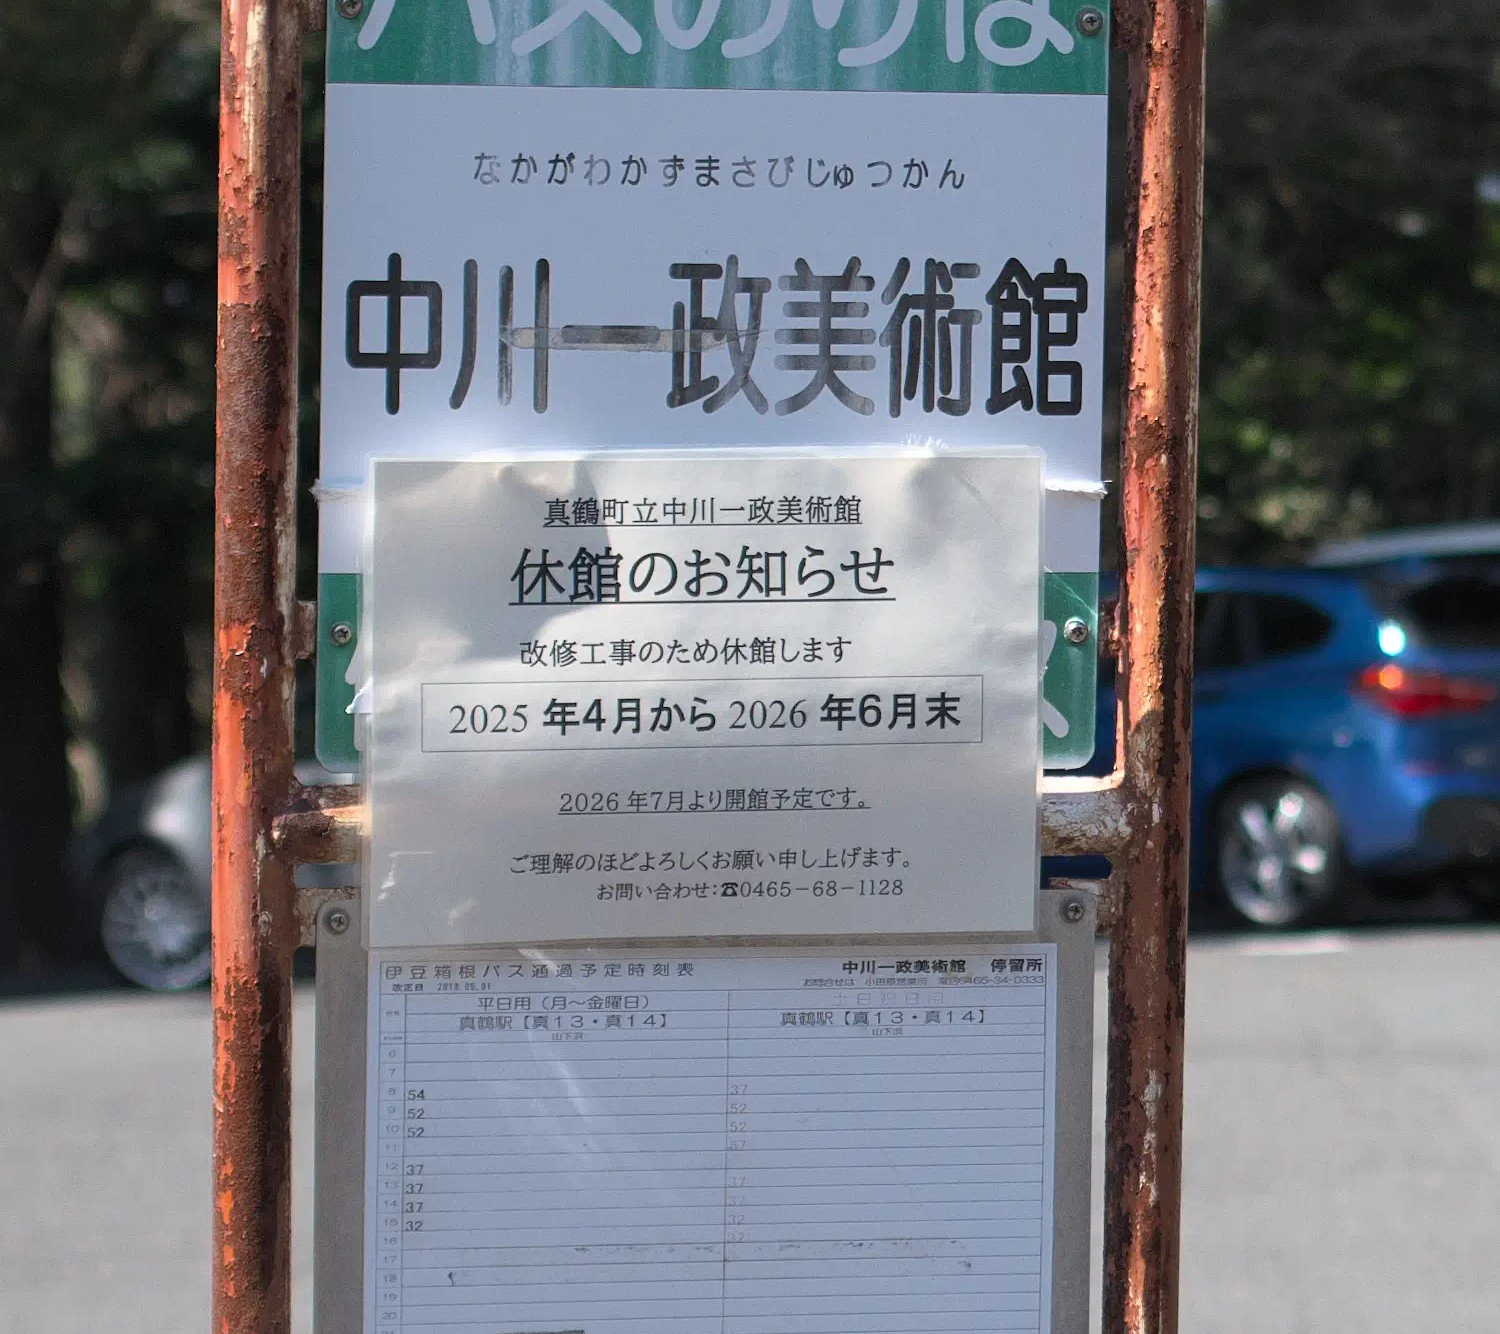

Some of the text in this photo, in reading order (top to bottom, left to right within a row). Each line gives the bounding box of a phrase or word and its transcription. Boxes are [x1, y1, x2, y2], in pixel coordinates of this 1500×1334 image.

[473, 150, 967, 191] なかがわかずまさびじゅつかん
[345, 252, 1088, 419] 中川一政美術館
[544, 496, 862, 525] 真鶴町立中川一政美術館
[510, 544, 895, 603] 休館のお知らせ
[520, 636, 851, 666] 改修工事のため休館します
[509, 847, 911, 875] ご理解のほどよろしくお願い申し上げます。
[385, 962, 695, 980] 伊豆箱根バス通過予定時刻表
[842, 958, 1042, 975] 中川一政美術館 停留所
[407, 1089, 425, 1100] 54
[407, 1108, 425, 1119] 52
[407, 1127, 425, 1138] 52
[406, 1164, 424, 1176] 37
[406, 1183, 424, 1194] 37
[406, 1202, 423, 1213] 37
[406, 1221, 423, 1232] 32
